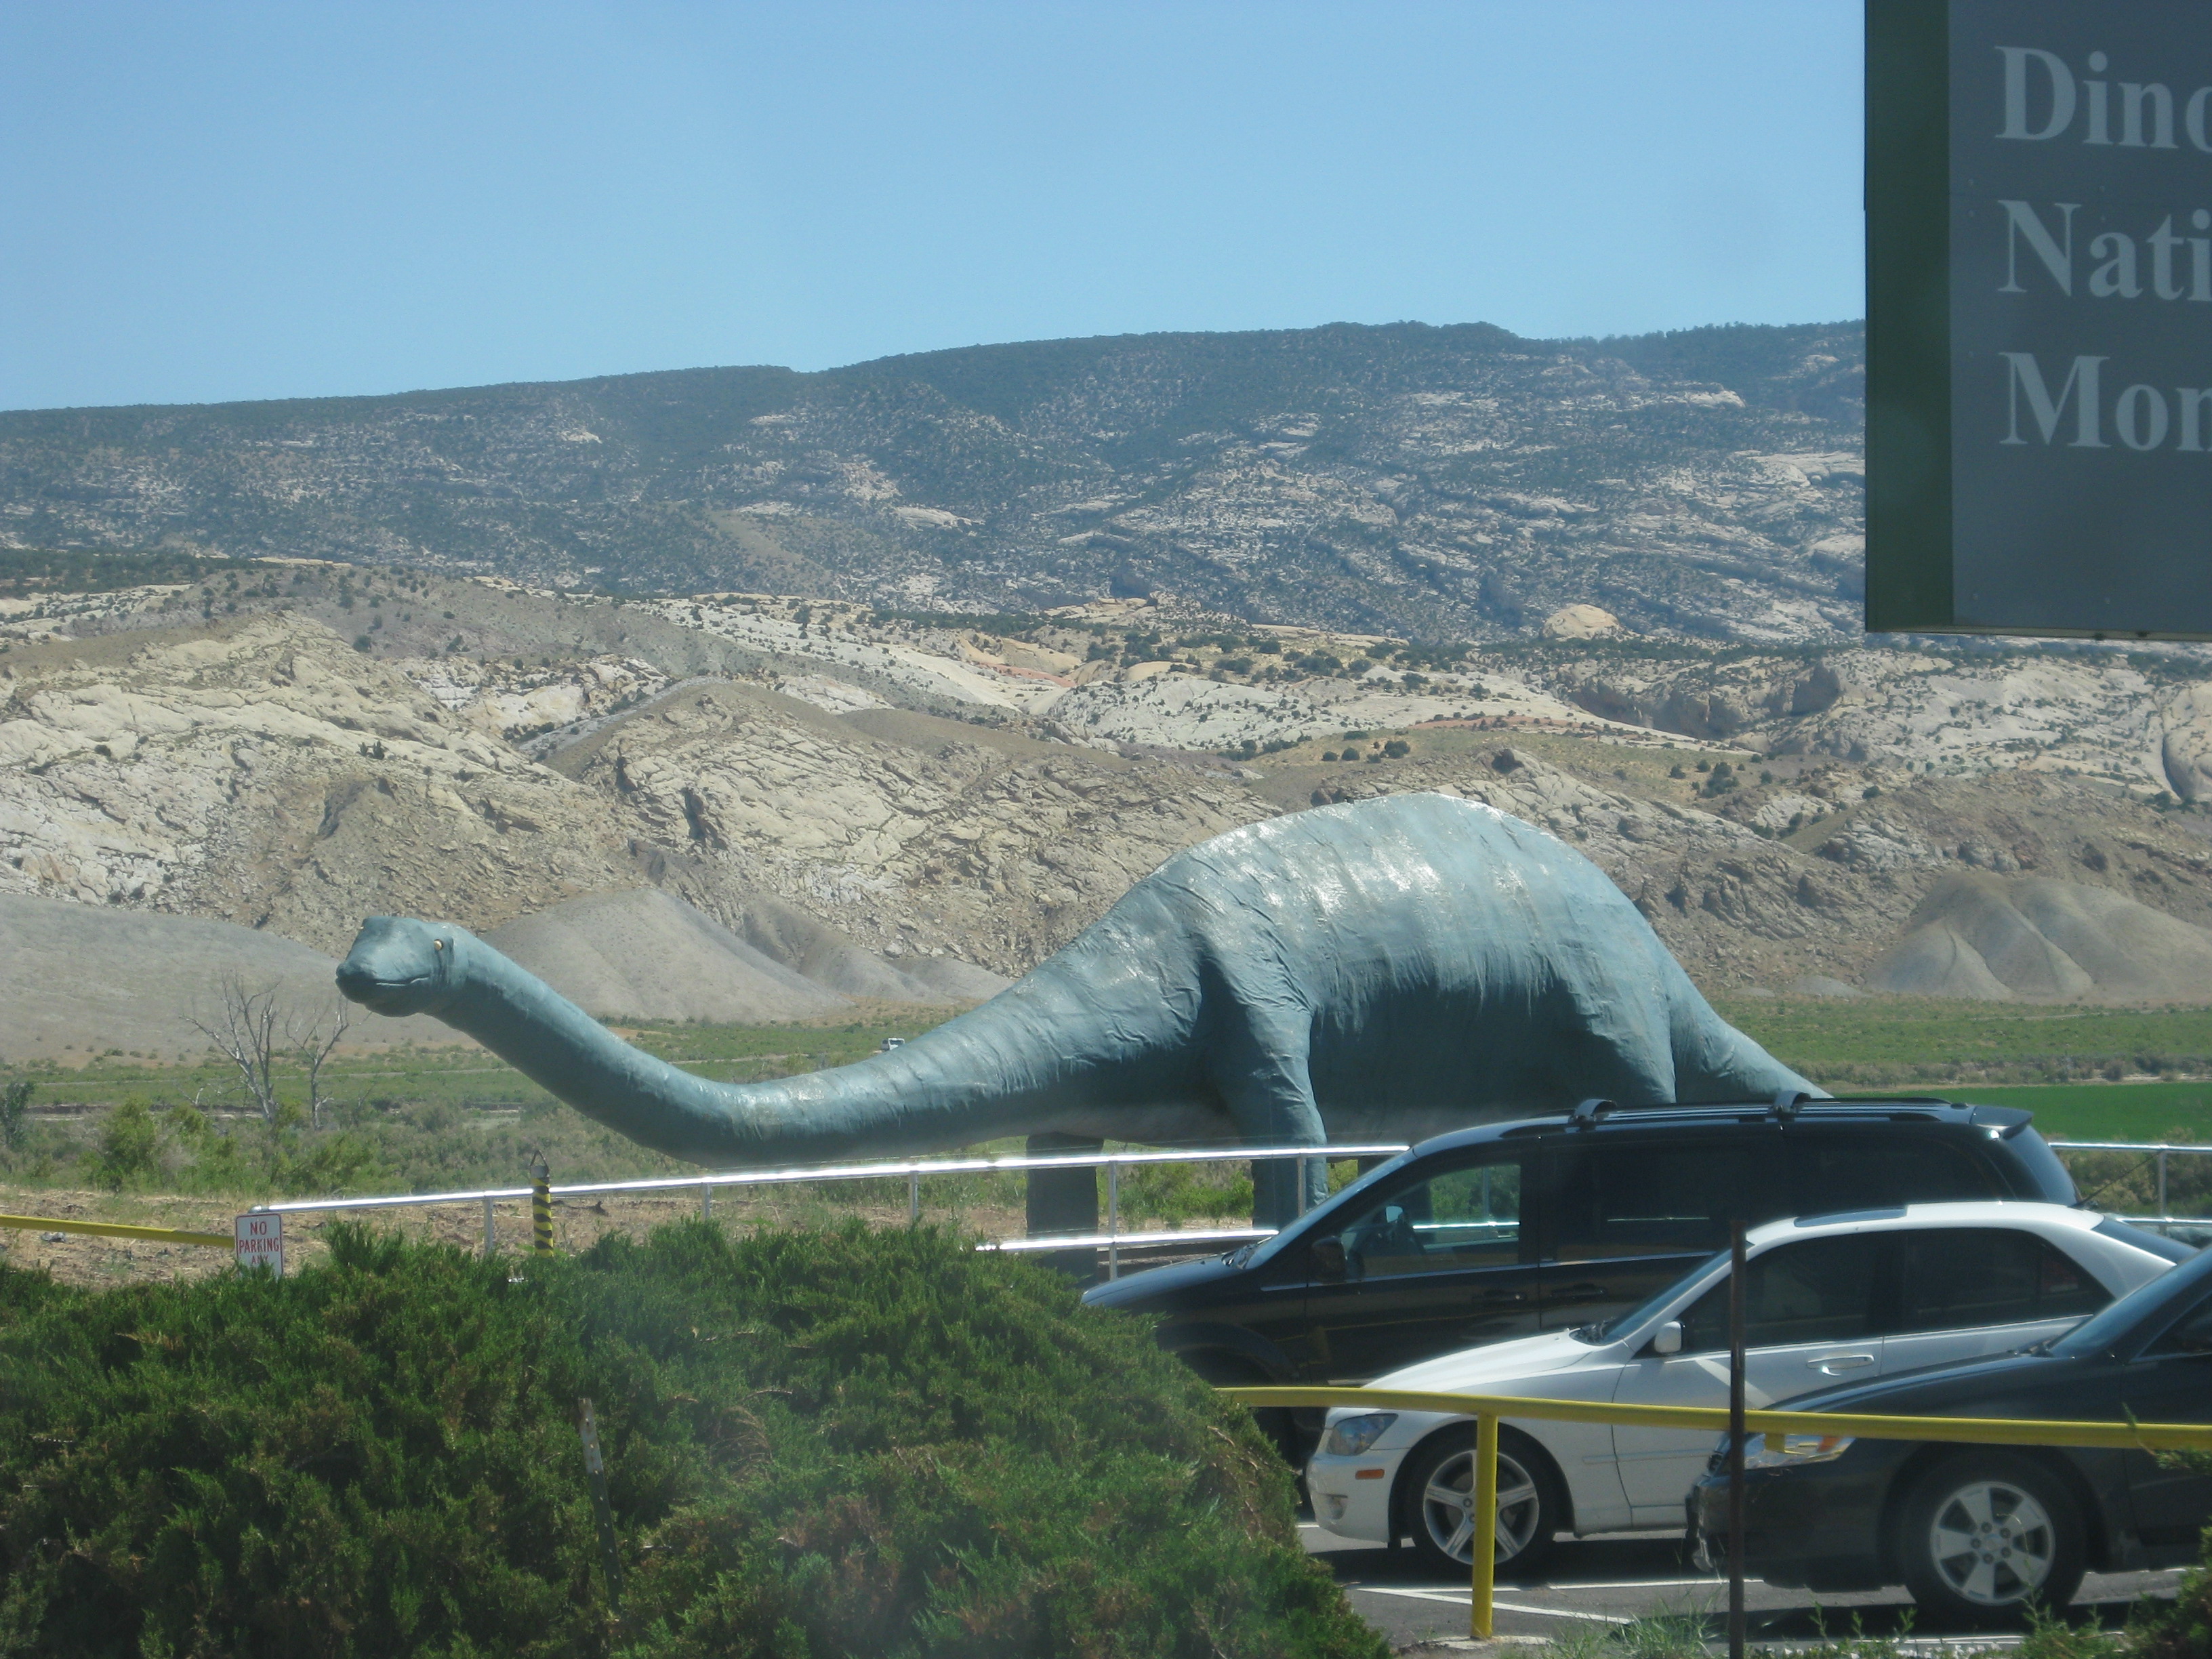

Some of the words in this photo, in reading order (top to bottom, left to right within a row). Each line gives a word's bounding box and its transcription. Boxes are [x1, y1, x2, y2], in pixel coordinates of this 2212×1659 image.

[1997, 199, 2212, 302] Nati
[250, 1221, 267, 1235] NO
[239, 1237, 279, 1254] PARKING
